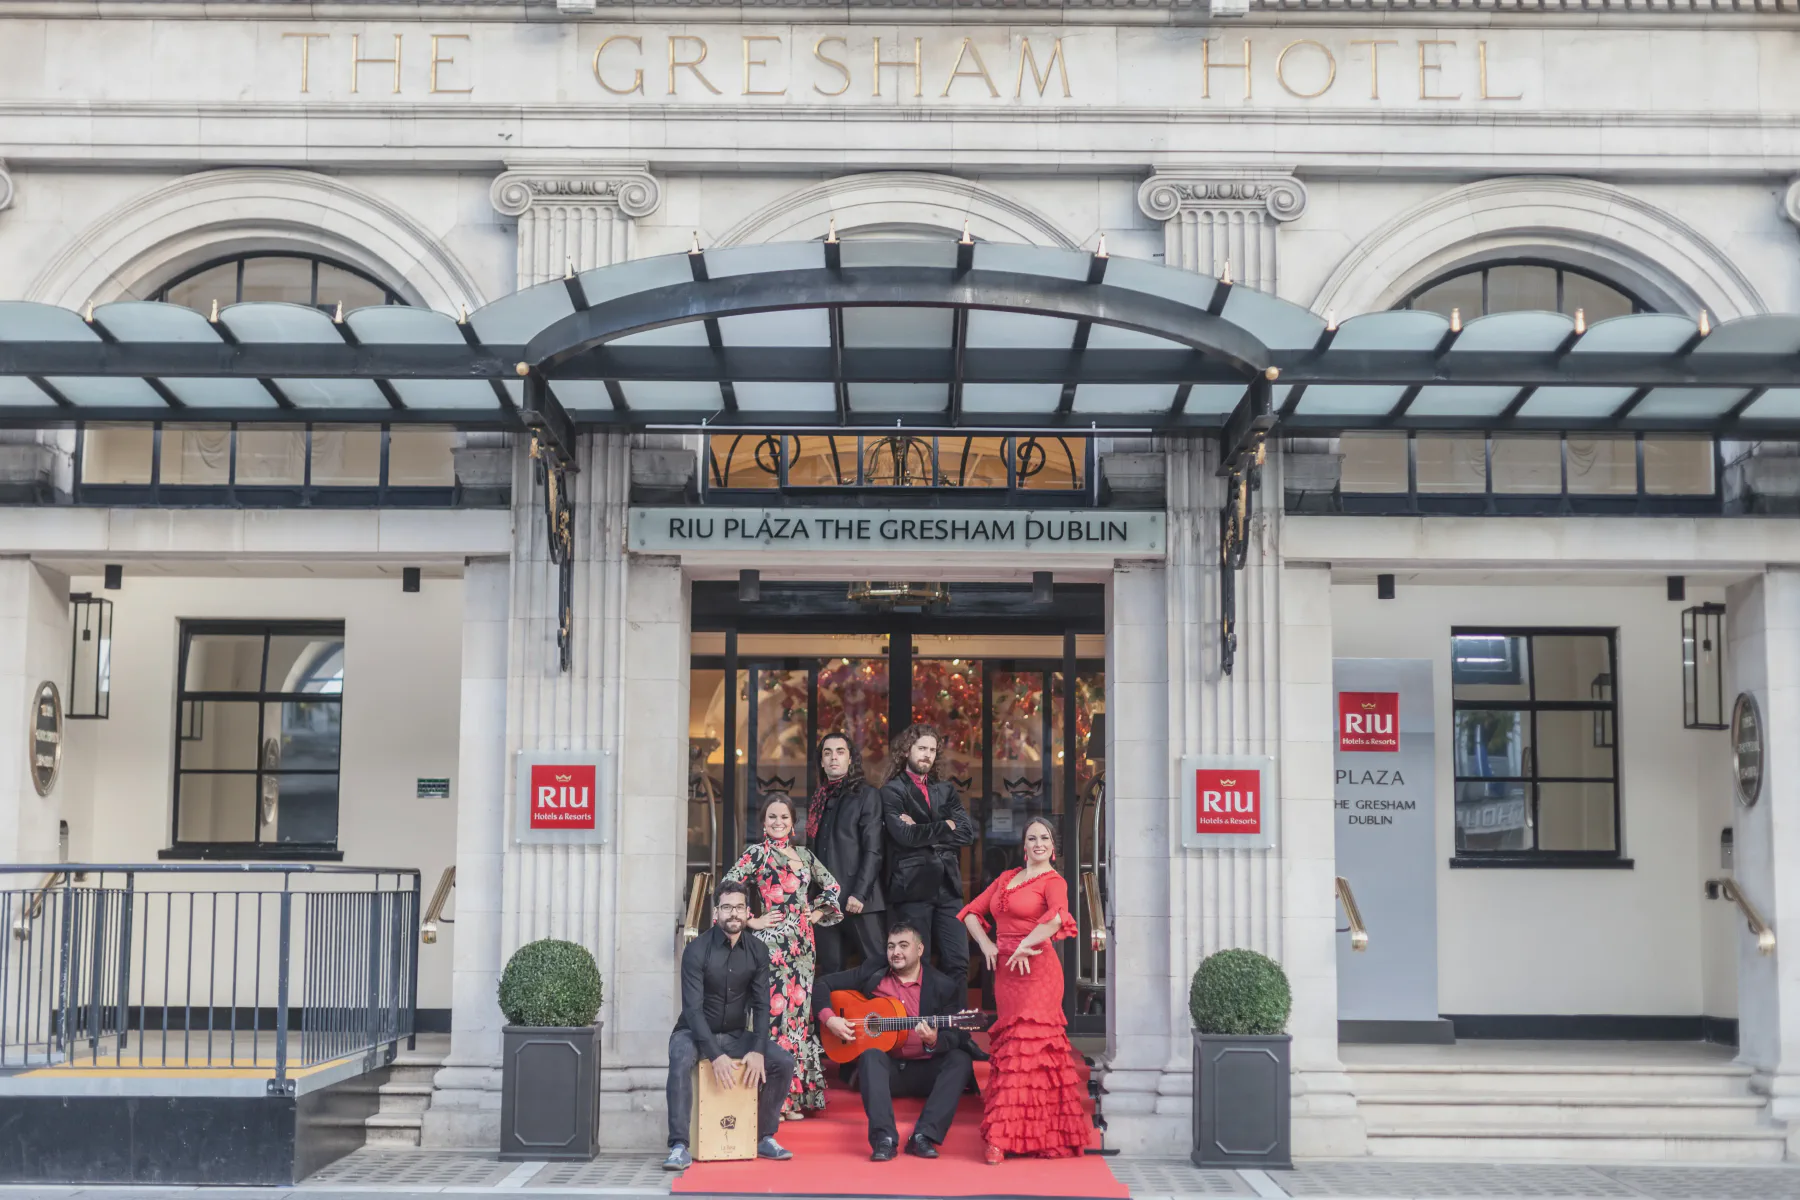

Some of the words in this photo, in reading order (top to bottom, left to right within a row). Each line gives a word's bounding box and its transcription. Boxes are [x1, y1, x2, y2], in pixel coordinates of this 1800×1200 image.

[281, 33, 474, 94] THE
[592, 34, 1074, 99] GRESHAM
[1201, 37, 1524, 100] HOTEL
[669, 518, 714, 539] RIU
[724, 518, 810, 540] PLAZA
[815, 519, 871, 540] THE
[879, 519, 1015, 541] GRESHAM
[1025, 521, 1127, 541] DUBLIN
[1345, 713, 1393, 734] RIU
[1342, 737, 1365, 745] Hotels
[1371, 738, 1396, 746] Resorts
[1335, 769, 1405, 785] PLAZA
[537, 786, 589, 808] RIU
[1203, 791, 1254, 813] RIU
[1334, 799, 1350, 810] HE
[1355, 800, 1416, 811] GRESHAM
[1348, 815, 1393, 825] DUBLIN
